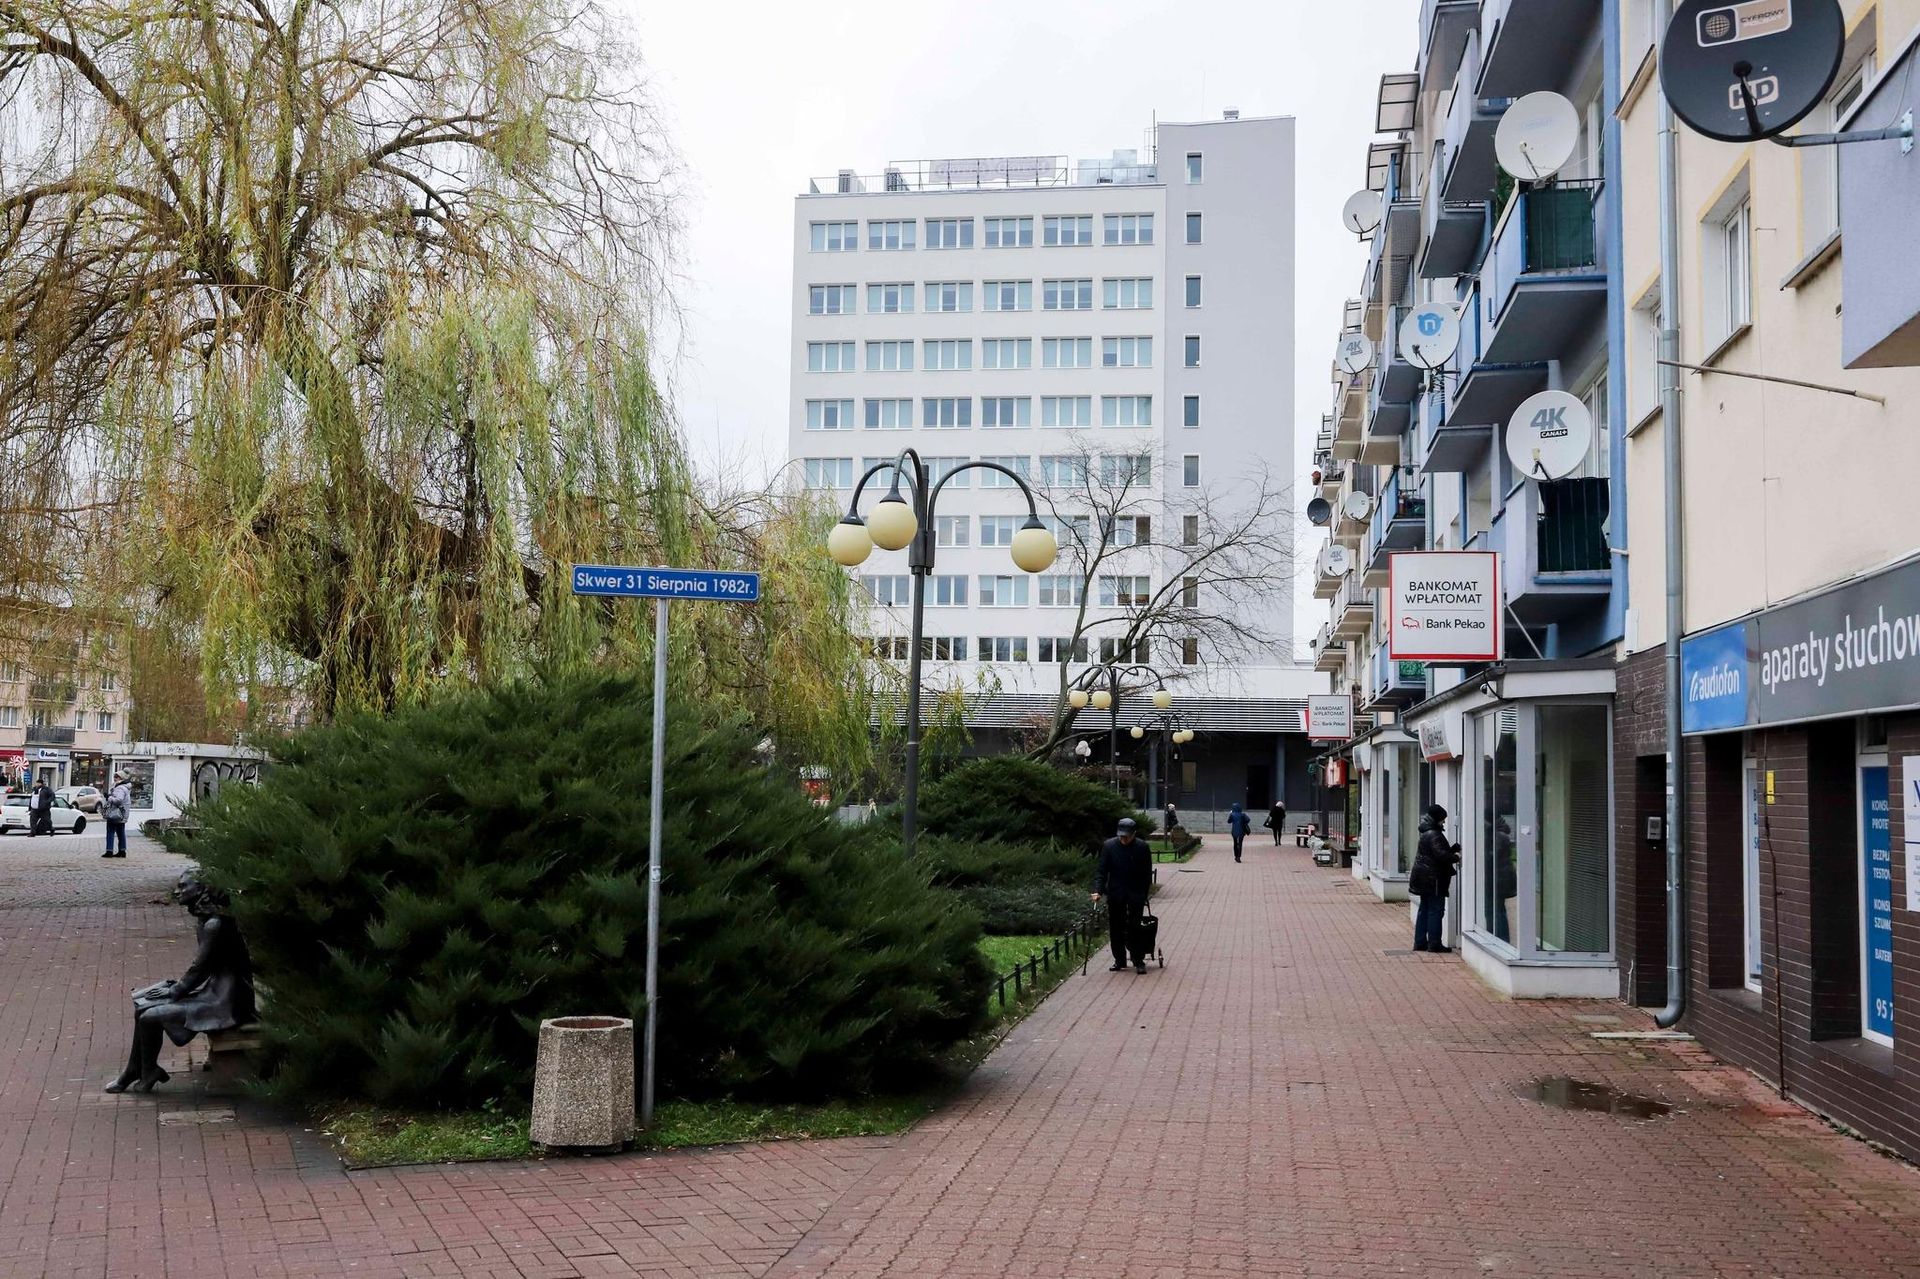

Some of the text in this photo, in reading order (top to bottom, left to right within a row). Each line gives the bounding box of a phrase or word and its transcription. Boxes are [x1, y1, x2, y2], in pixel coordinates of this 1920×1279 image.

[1740, 8, 1785, 23] CYFROWY
[1346, 340, 1362, 352] 4K
[1530, 407, 1567, 430] 4K
[1541, 430, 1567, 438] CANAL+
[576, 572, 753, 594] Skwer 31 Sierpnia 1982r.
[1409, 581, 1478, 591] BANKOMAT
[1405, 593, 1482, 604] WPŁATOMAT
[1426, 618, 1485, 629] Bank Pekao
[1762, 631, 1829, 694] aparaty
[1699, 663, 1740, 701] audiofon
[1876, 998, 1887, 1019] 95
